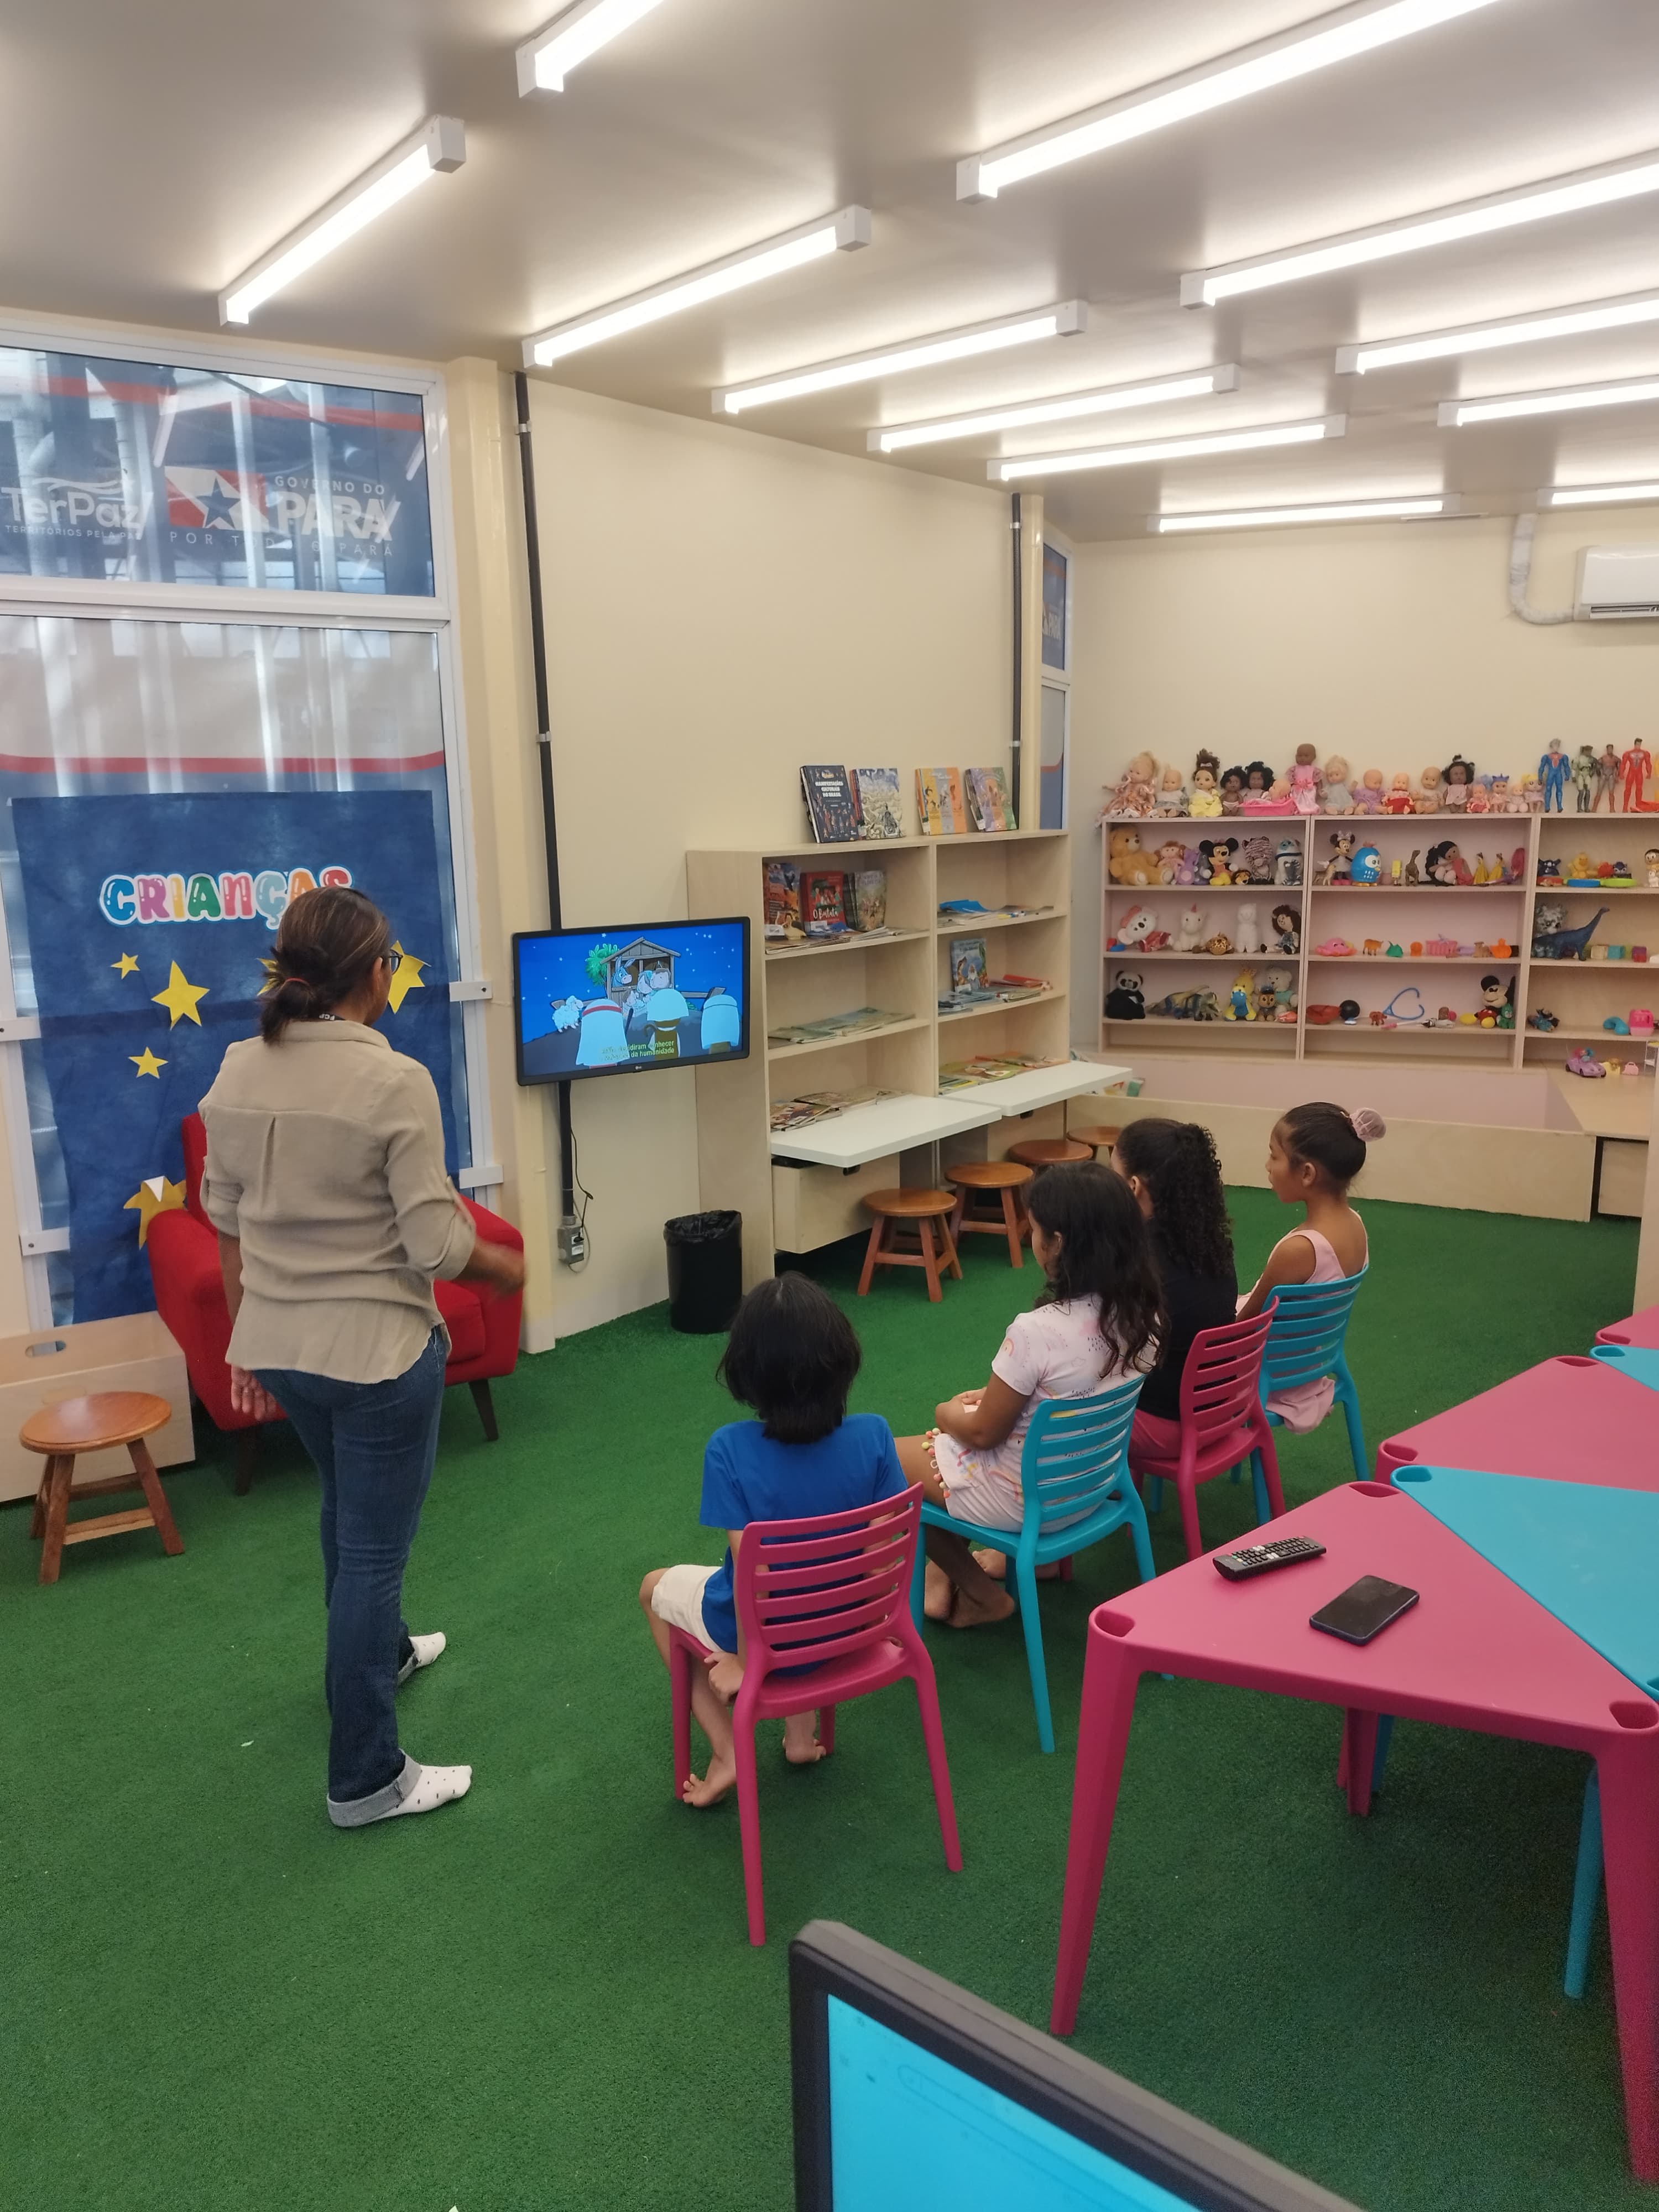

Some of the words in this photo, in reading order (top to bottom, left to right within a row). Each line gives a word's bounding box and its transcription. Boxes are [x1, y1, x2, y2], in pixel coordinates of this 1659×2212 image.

[275, 476, 354, 493] GOVERNO
[363, 483, 384, 495] DO
[1, 487, 142, 528] TerPaz
[6, 525, 82, 537] TERRITÓRIOS
[87, 530, 115, 539] PELA
[170, 531, 213, 545] POR
[340, 542, 392, 556] PARÁ
[813, 909, 818, 919] O
